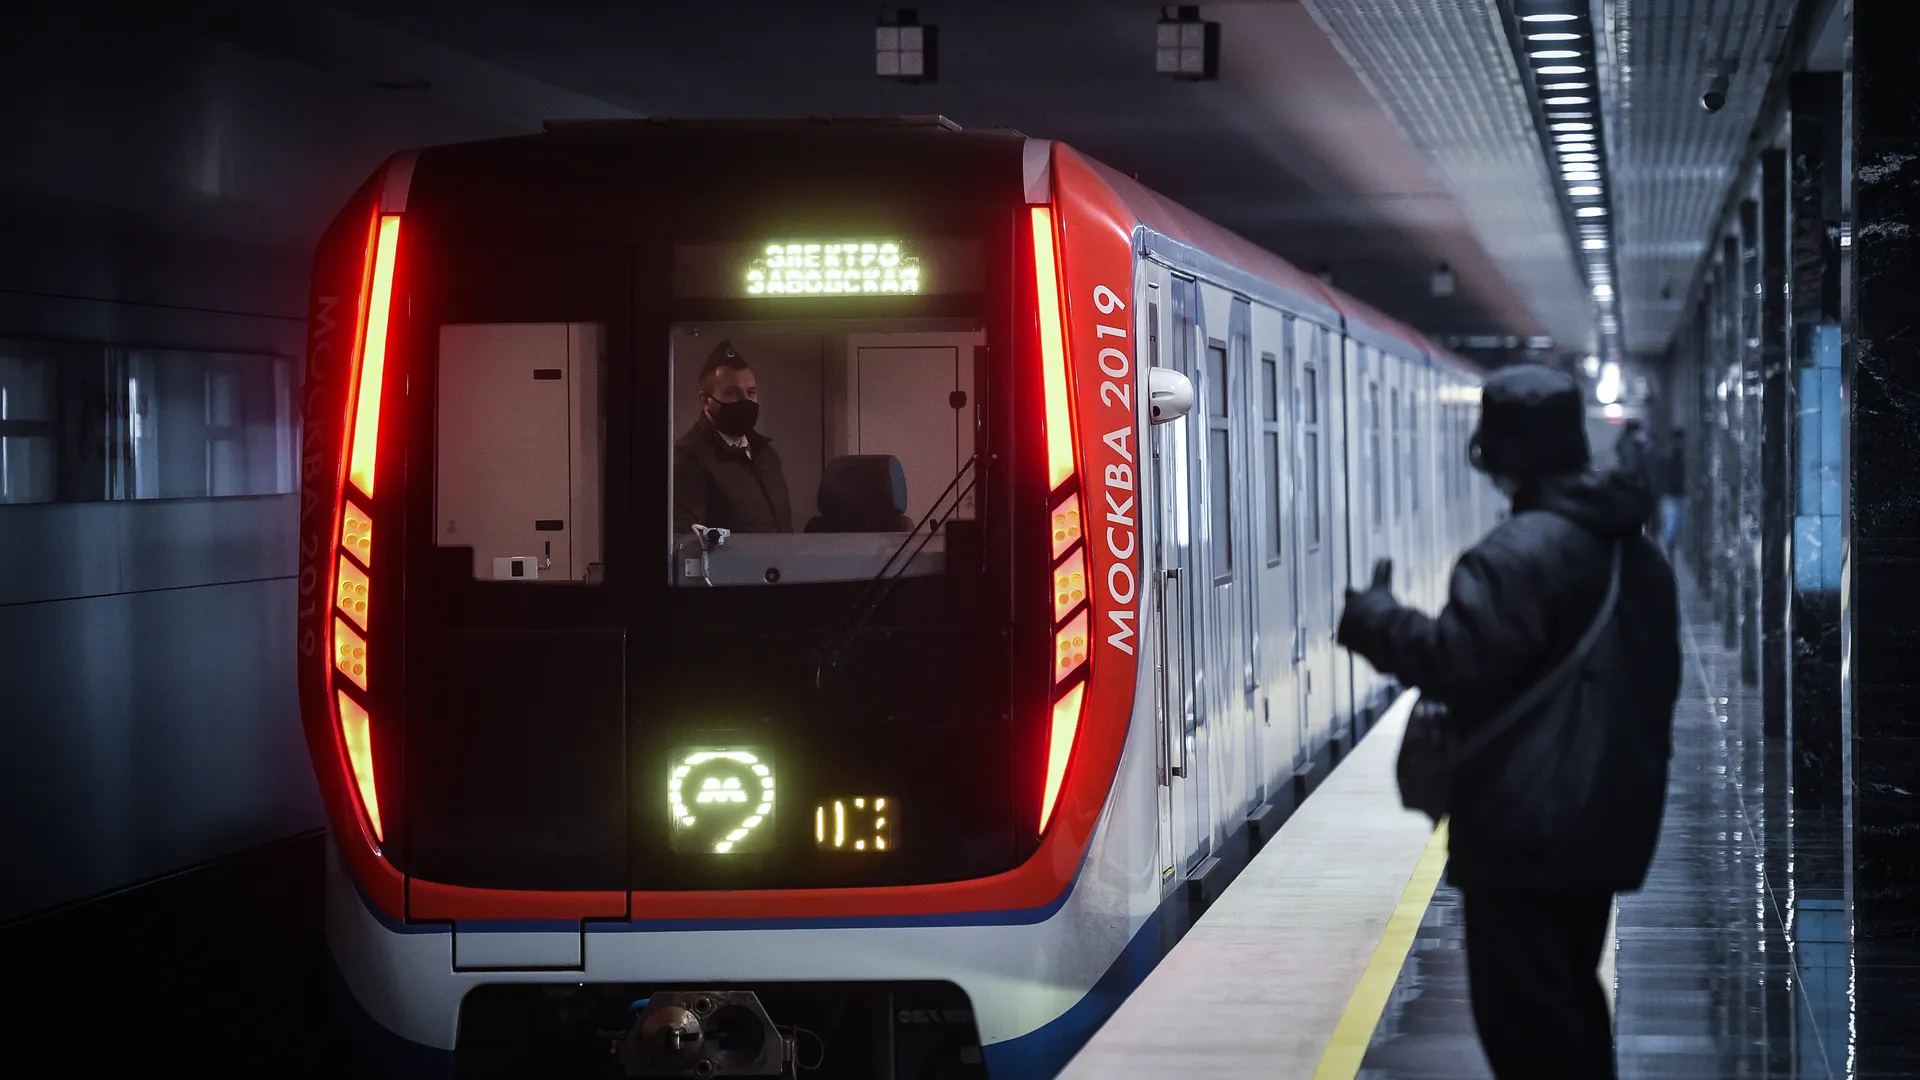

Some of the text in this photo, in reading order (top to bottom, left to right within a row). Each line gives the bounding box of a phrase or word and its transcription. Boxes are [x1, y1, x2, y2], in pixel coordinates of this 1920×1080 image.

[748, 268, 919, 294] ЗАВОДСКАЯ
[766, 243, 899, 267] ЭЛЕКТРО
[299, 295, 340, 659] МОСКВА 2019
[1093, 284, 1135, 655] МОСКВА 2019
